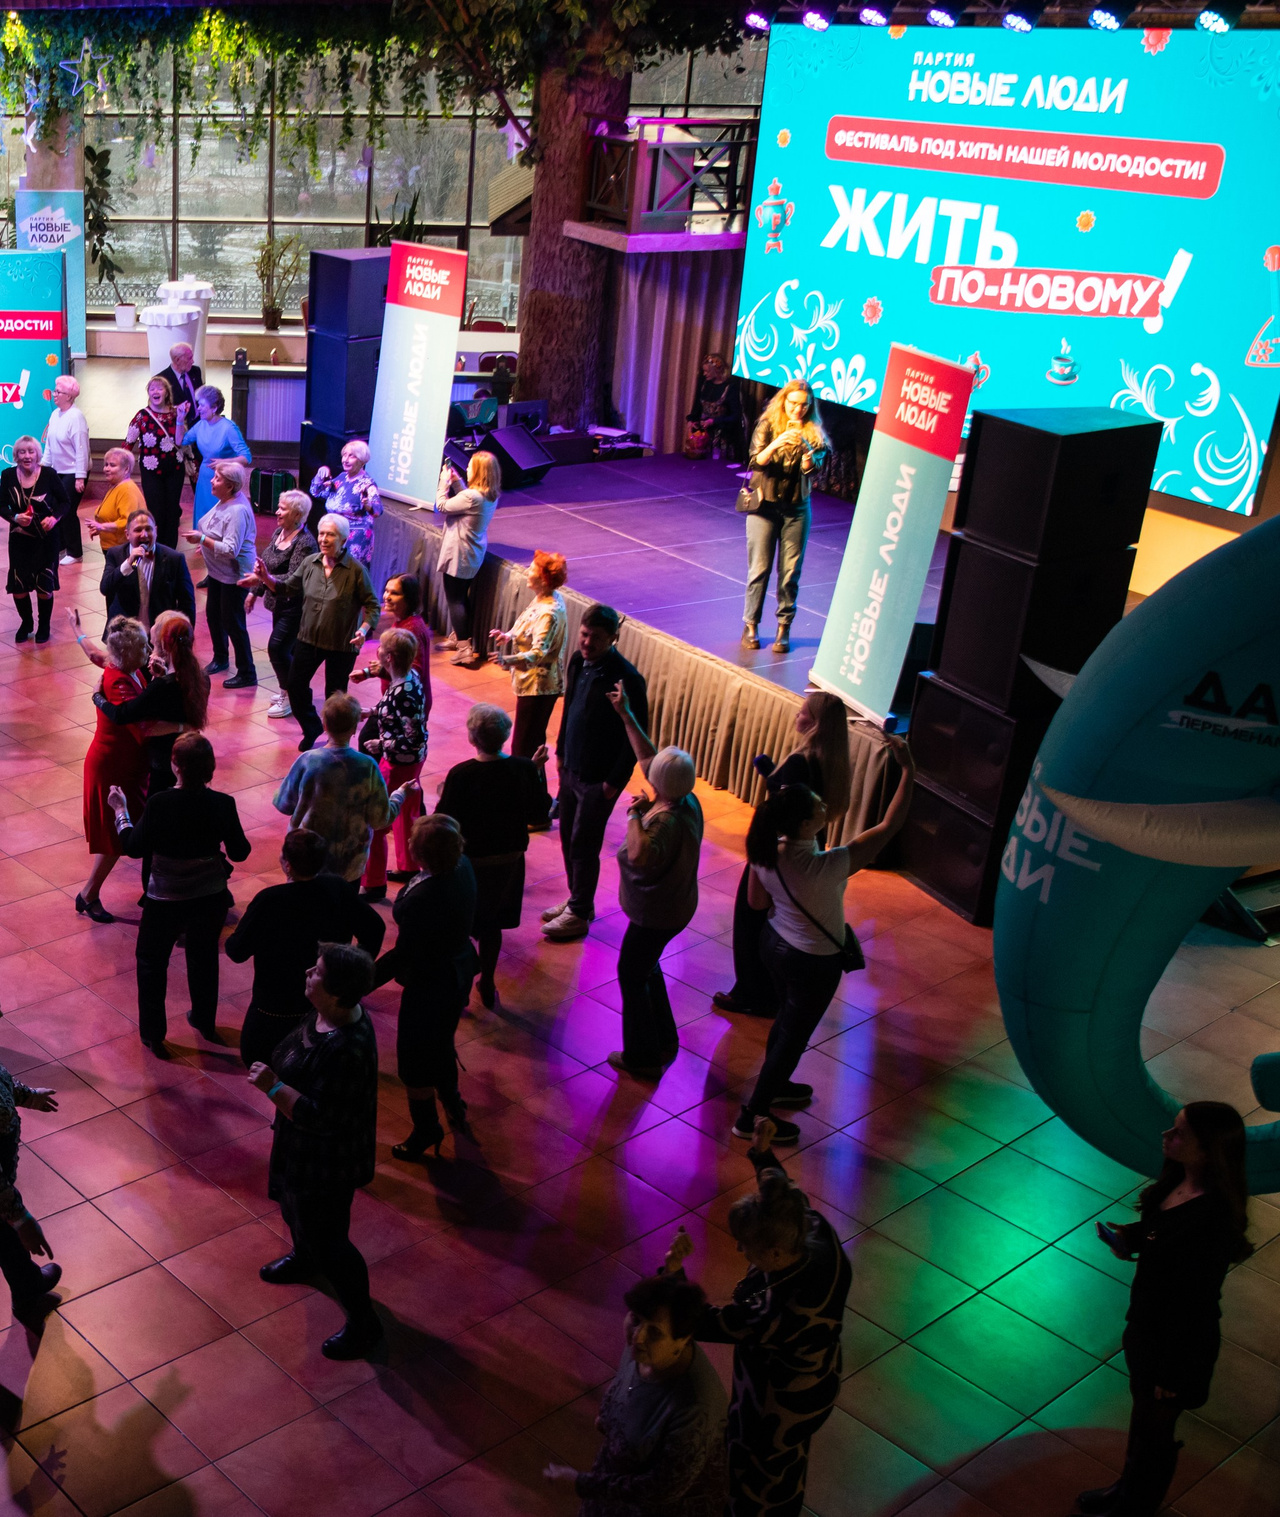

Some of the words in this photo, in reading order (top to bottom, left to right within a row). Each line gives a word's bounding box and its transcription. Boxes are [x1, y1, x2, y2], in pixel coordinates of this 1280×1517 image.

[913, 51, 975, 67] ПАРТИЯ
[908, 69, 1019, 107] НОВЫЕ
[1020, 74, 1129, 114] ЛЮДИ
[834, 129, 919, 154] ФЕСТИВАЛЬ
[920, 137, 956, 160] ПОД
[957, 141, 1004, 162] ХИТЫ
[1005, 145, 1070, 168] НАШЕЙ
[1071, 150, 1208, 181] МОЛОДОСТИ!
[29, 222, 72, 233] НОВЫЕ
[30, 233, 65, 243] ЛЮДИ
[820, 184, 1018, 268] ЖИТЬ
[405, 264, 450, 286] НОВЫЕ
[407, 256, 434, 266] ПАРТИЯ
[404, 281, 442, 301] ЛЮДИ
[936, 248, 1194, 334] ПО-НОВОМУ!
[905, 368, 934, 385] ПАРТИЯ
[395, 399, 419, 485] НОВЫЕ
[407, 324, 429, 398] ЛЮДИ
[901, 379, 952, 414] НОВЫЕ
[895, 403, 938, 434] ЛЮДИ
[387, 432, 399, 481] ПАРТИЯ
[846, 568, 890, 687] НОВЫЕ
[878, 463, 918, 566] ЛЮДИ
[839, 610, 862, 677] ПАРТИЯ
